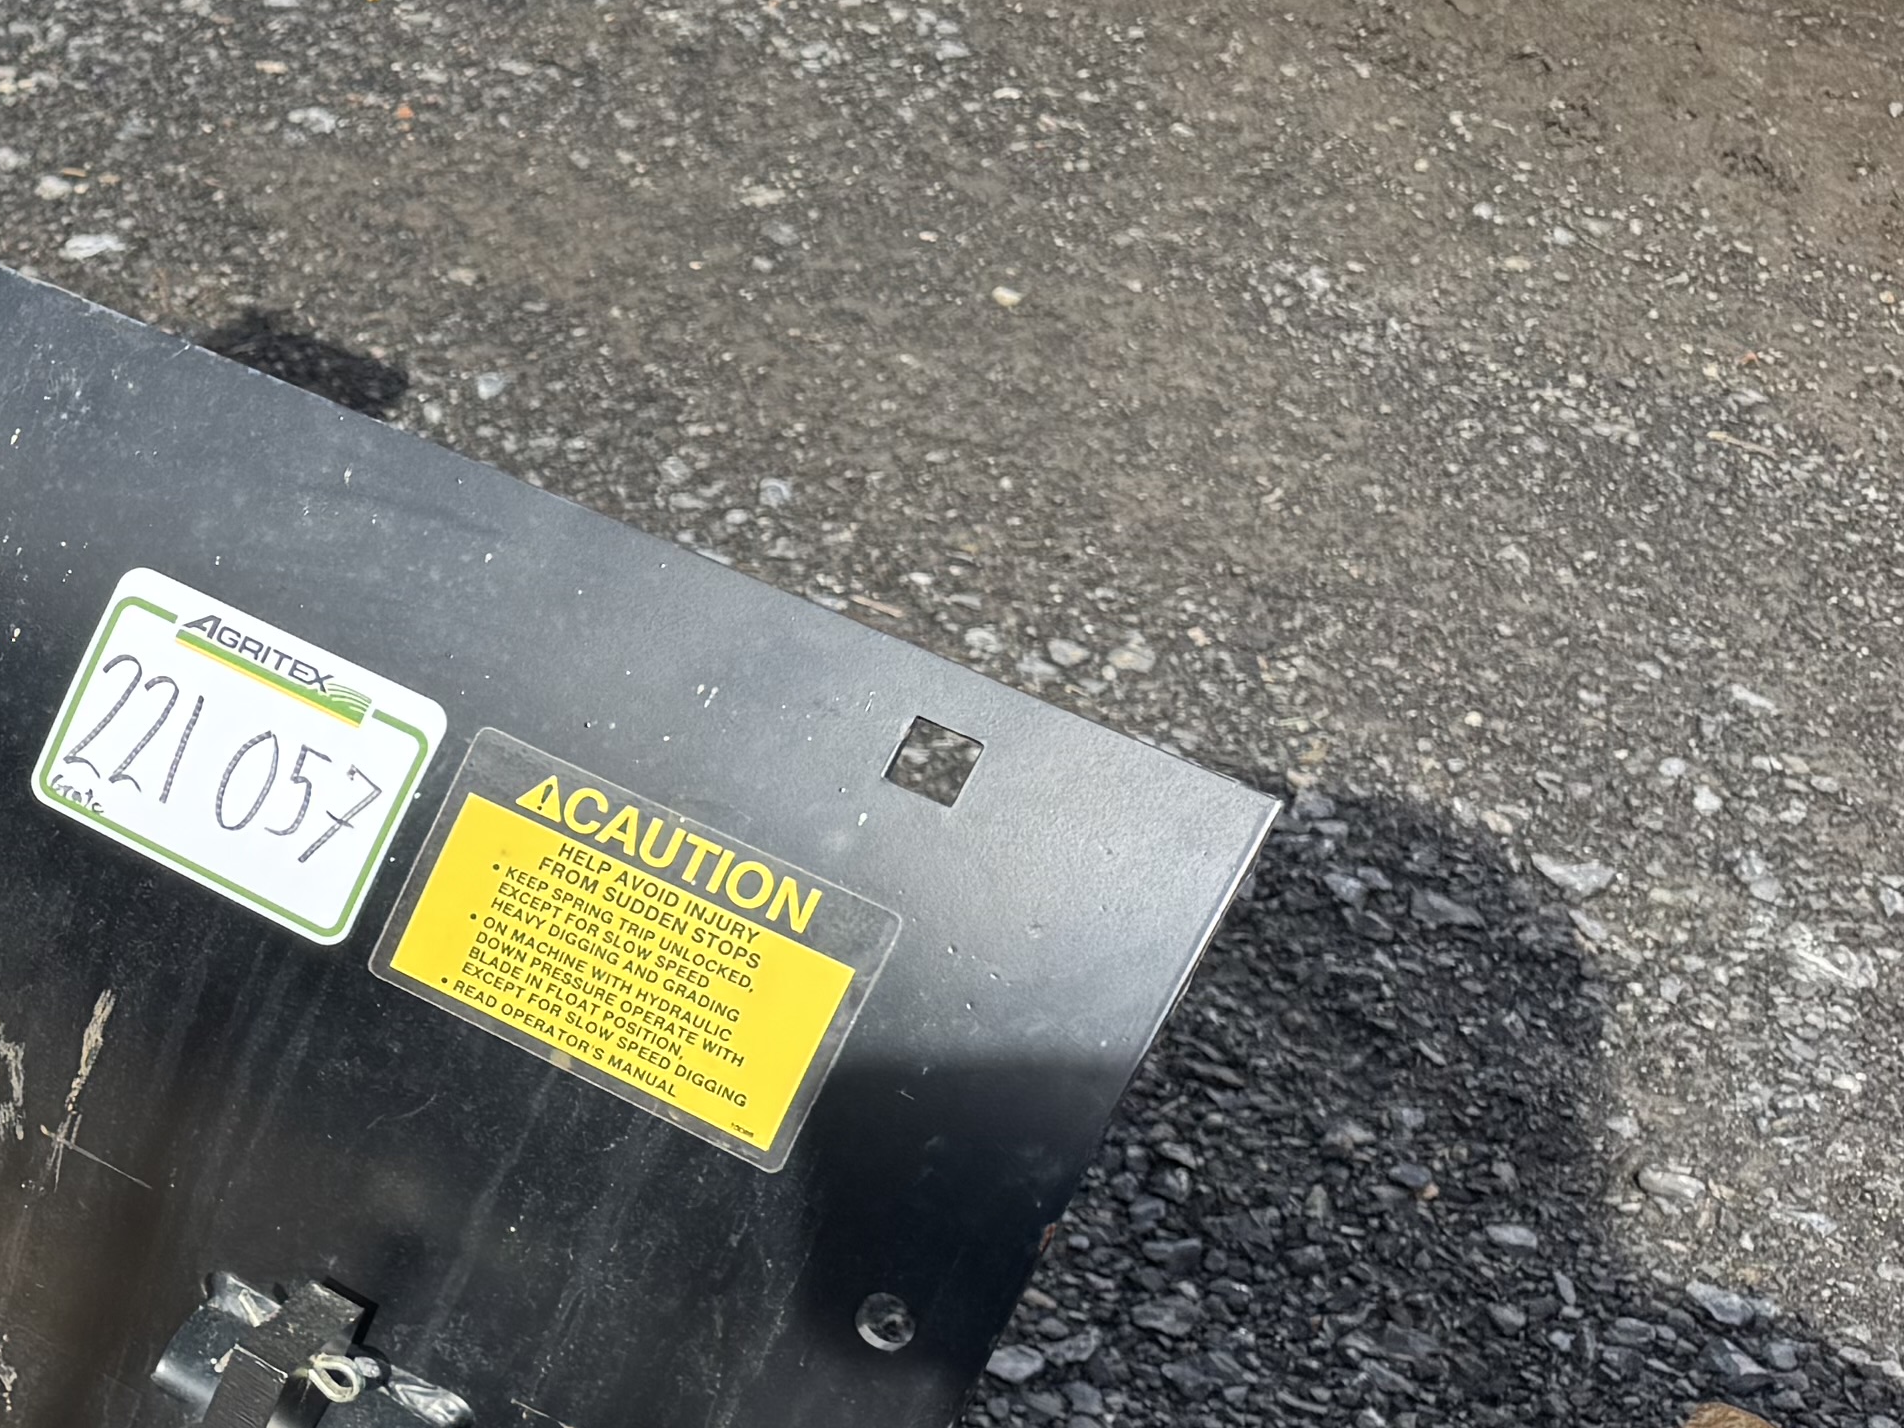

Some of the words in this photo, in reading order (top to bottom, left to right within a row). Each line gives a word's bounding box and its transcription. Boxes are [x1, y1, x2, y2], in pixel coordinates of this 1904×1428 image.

[183, 614, 333, 693] AGRITEX
[63, 653, 204, 802] 221
[214, 730, 381, 862] 057
[537, 855, 599, 894] FROM
[601, 885, 688, 935] SUDDEN
[690, 926, 761, 969] STOPS
[557, 841, 612, 874] HELP
[613, 869, 679, 907] AVOID
[682, 899, 760, 944] INJURY
[564, 788, 822, 934] CAUTION
[482, 915, 508, 936] ON
[509, 928, 588, 973] MACHINE
[591, 964, 633, 995] WITH
[634, 987, 732, 1042] HYDRAULIC
[490, 896, 547, 930] HEAVY
[547, 922, 620, 965] DIGGING
[621, 959, 659, 984] AND
[662, 977, 740, 1022] GRADING
[497, 881, 563, 919] EXCEPT
[563, 911, 600, 937] FOR
[601, 929, 653, 961] SLOW
[653, 954, 710, 988] SPEED
[504, 865, 549, 892] KEEP
[550, 887, 614, 925] SPRING
[618, 916, 656, 941] TRIP
[658, 936, 753, 993] UNLOCKED,
[452, 978, 497, 1008] READ
[500, 1002, 604, 1060] OPERATOR'S
[606, 1053, 676, 1098] MANUAL
[460, 960, 526, 999] EXCEPT
[526, 991, 562, 1017] FOR
[564, 1010, 615, 1041] SLOW
[615, 1035, 671, 1070] SPEED
[673, 1063, 747, 1107] DIGGING
[467, 945, 523, 980] BLADE
[523, 971, 543, 990] IN
[544, 981, 601, 1016] FLOAT
[601, 1009, 683, 1060] POSITION,
[474, 930, 528, 963] DOWN
[528, 956, 617, 1006] PRESSURE
[619, 999, 699, 1045] OPERATE
[701, 1037, 745, 1067] WITH
